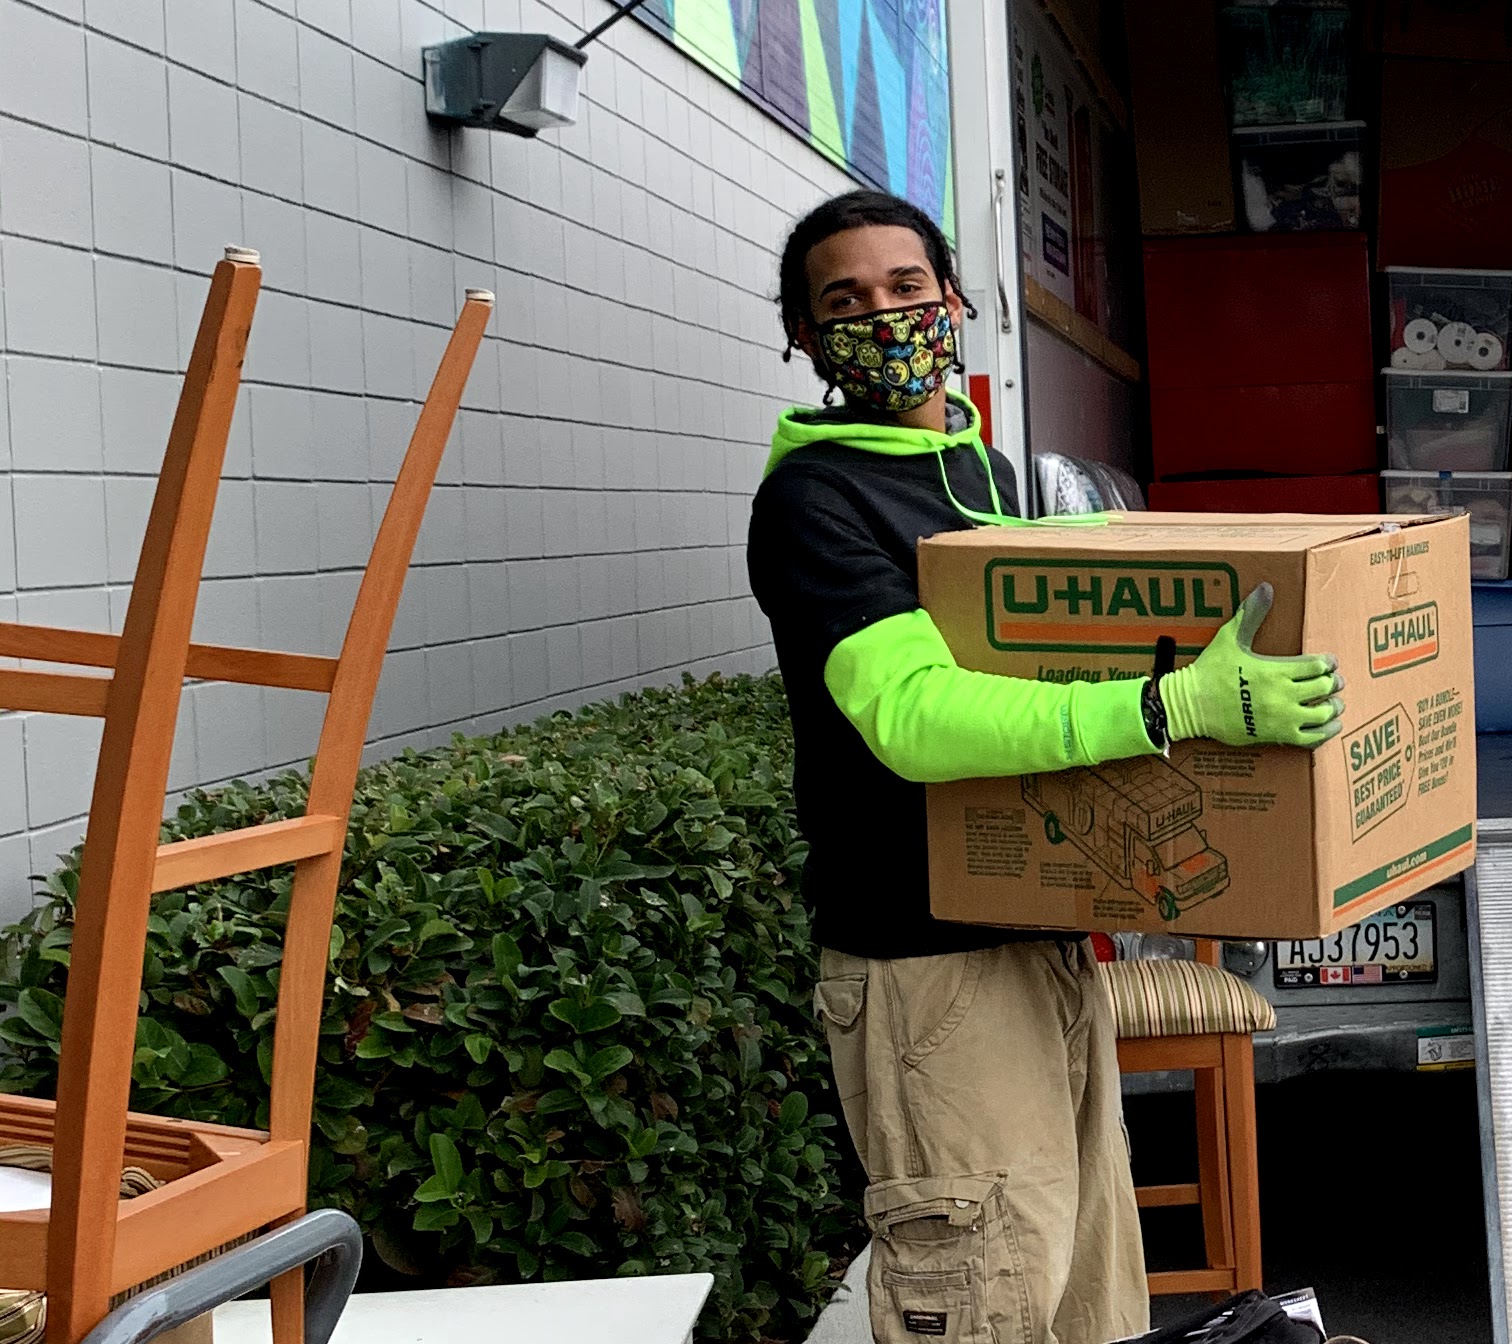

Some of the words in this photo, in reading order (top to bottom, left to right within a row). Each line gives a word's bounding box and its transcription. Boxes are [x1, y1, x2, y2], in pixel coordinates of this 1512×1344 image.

[1002, 573, 1224, 618] U-HAUL
[1373, 611, 1436, 654] U-HAUL
[1037, 665, 1102, 684] Loading
[1240, 675, 1258, 738] HARDY
[1350, 715, 1401, 772] SAVE!
[1354, 781, 1376, 808] BEST
[1377, 759, 1401, 791] PRICE
[1155, 800, 1200, 830] U-HAUL
[1355, 786, 1403, 829] GUARANTEED
[1386, 851, 1428, 879] uhaul.com
[1289, 921, 1419, 965] AJ37953
